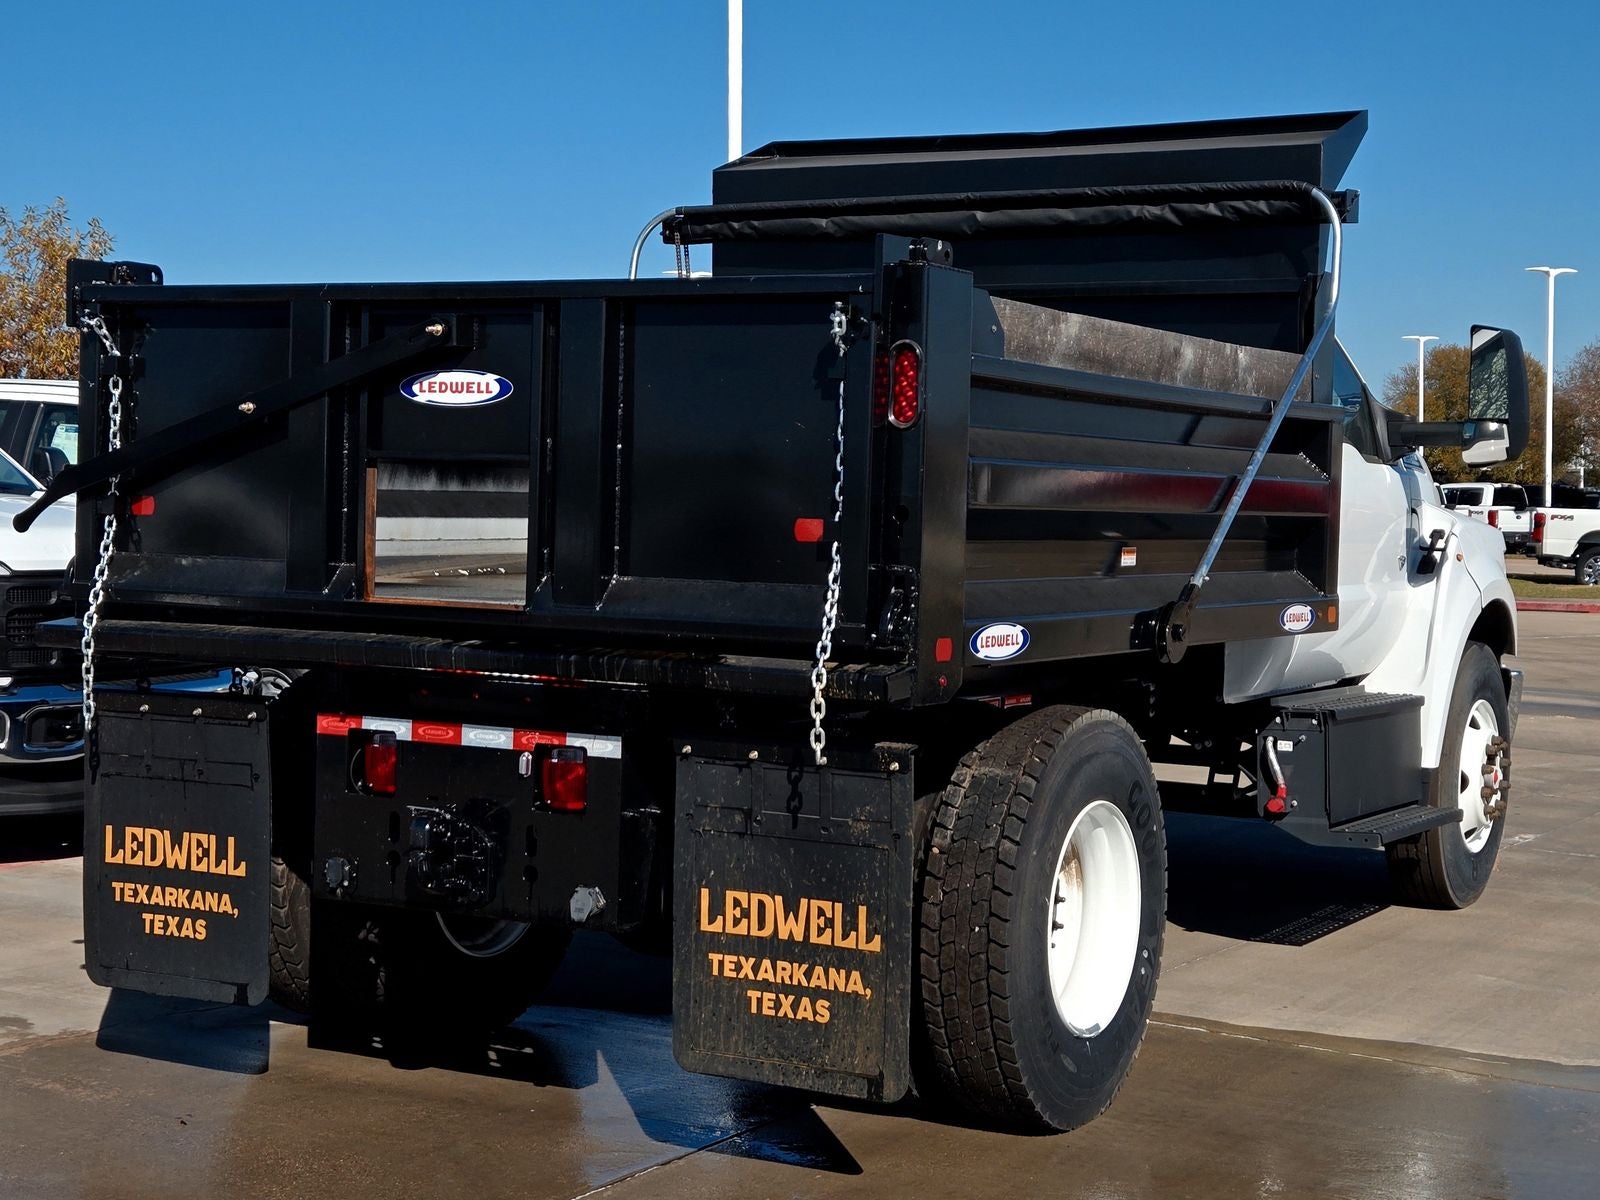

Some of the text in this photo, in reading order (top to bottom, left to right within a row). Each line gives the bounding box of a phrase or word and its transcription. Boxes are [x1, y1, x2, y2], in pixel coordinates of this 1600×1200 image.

[419, 381, 493, 394] LEDWELL
[1286, 612, 1309, 623] LEDWELL
[980, 633, 1019, 648] LEDWELL
[105, 824, 246, 877] LEDWELL
[111, 881, 239, 918] TEXARKANA,
[142, 912, 207, 940] TEXAS
[700, 887, 881, 952] LEDWELL
[708, 953, 872, 999] TEXARKANA,
[747, 989, 831, 1024] TEXAS
